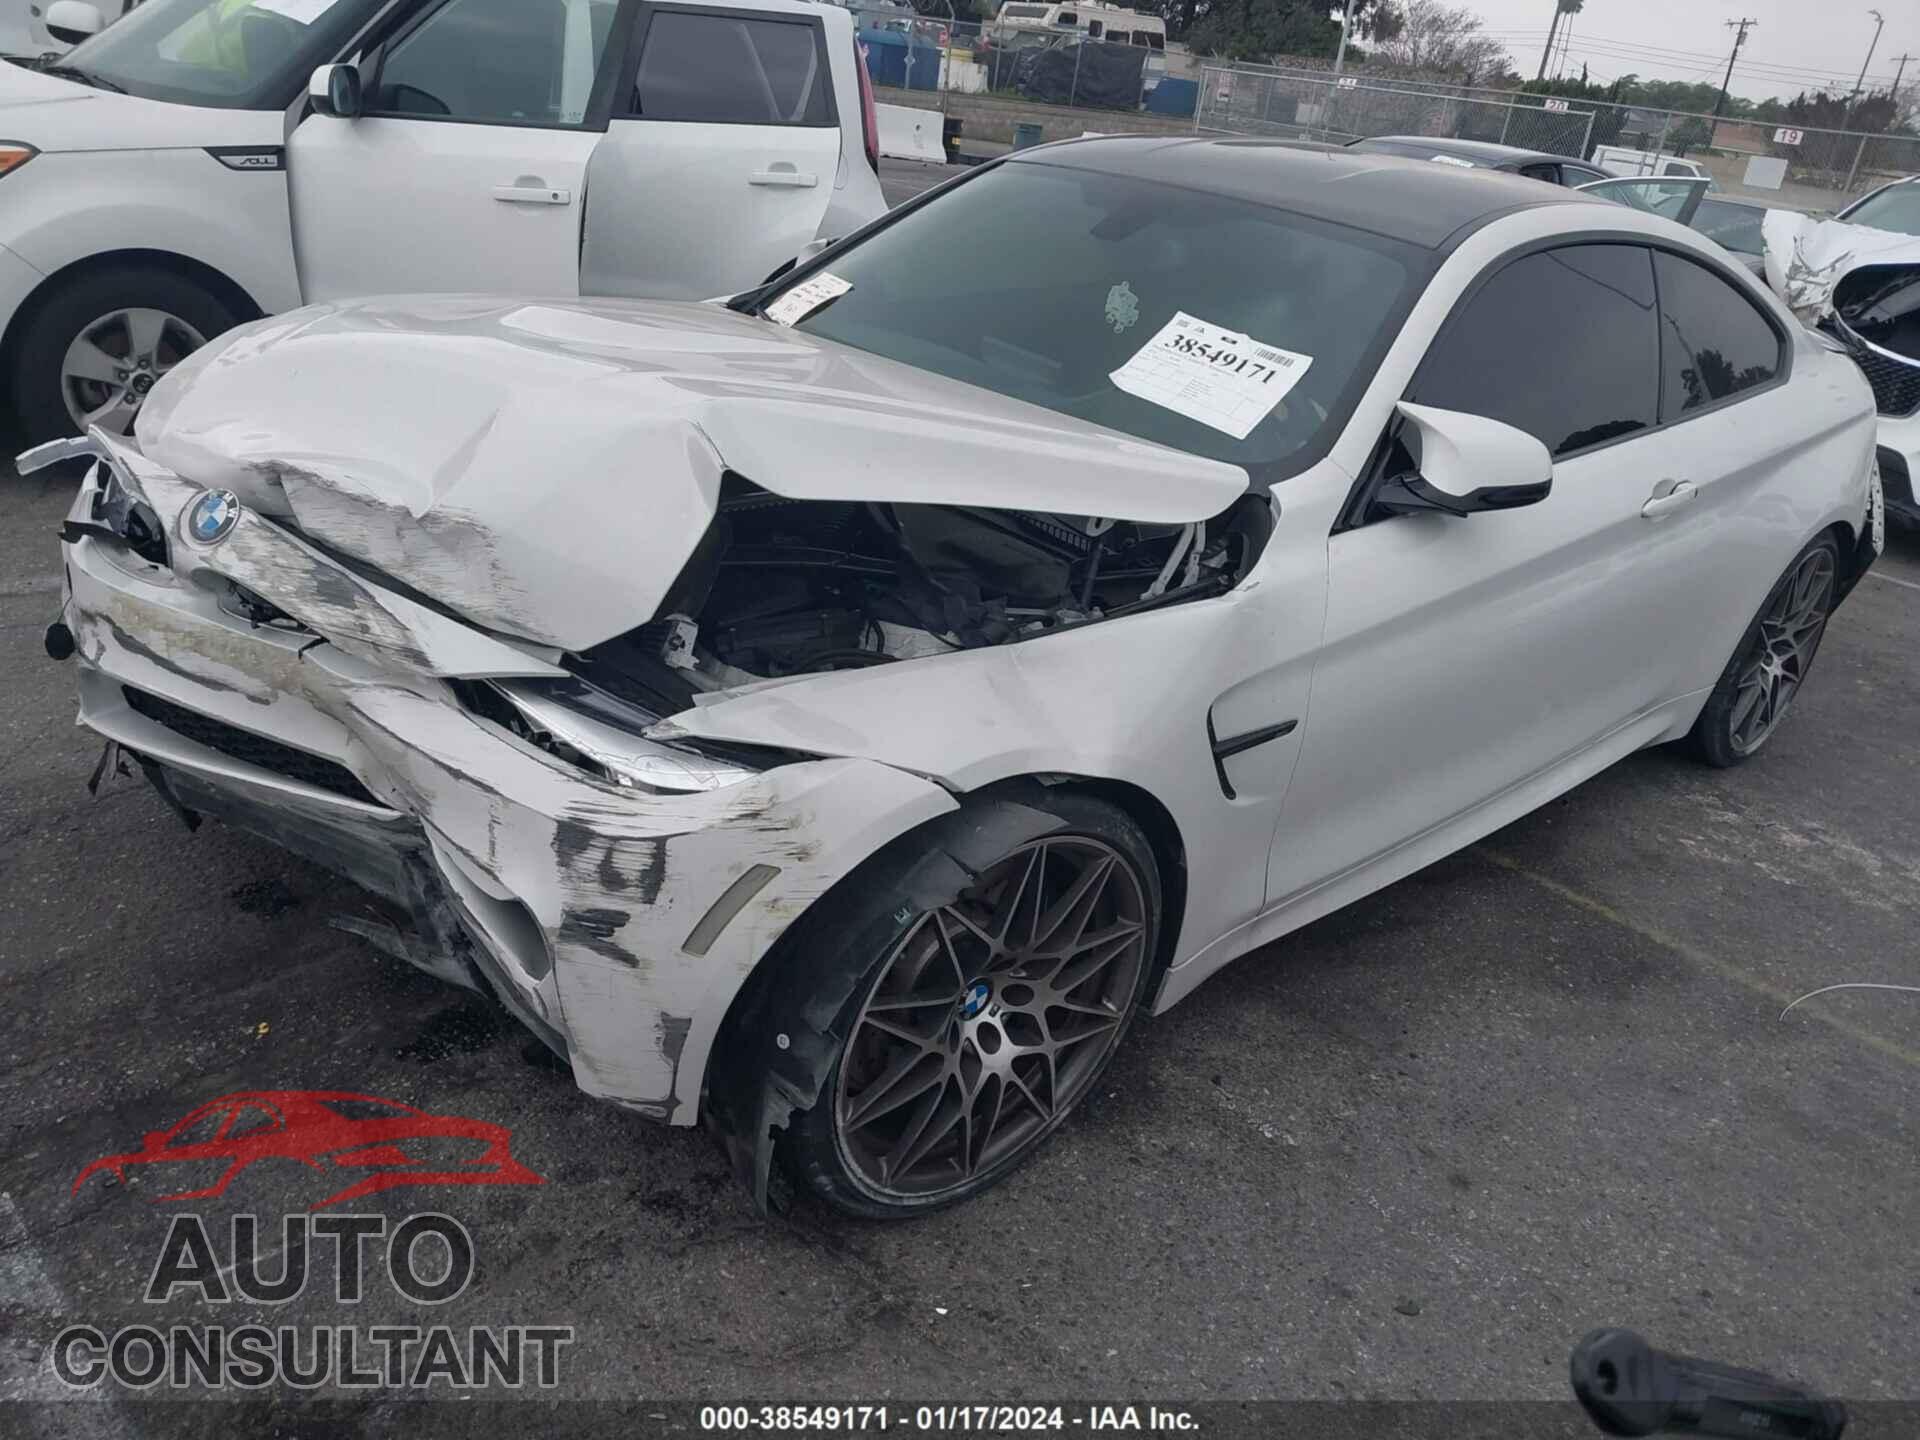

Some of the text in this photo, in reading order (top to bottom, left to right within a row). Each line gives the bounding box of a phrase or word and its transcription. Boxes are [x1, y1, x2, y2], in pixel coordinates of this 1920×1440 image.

[1548, 100, 1567, 111] 20
[1780, 129, 1799, 143] 19
[1163, 333, 1277, 385] 38549171
